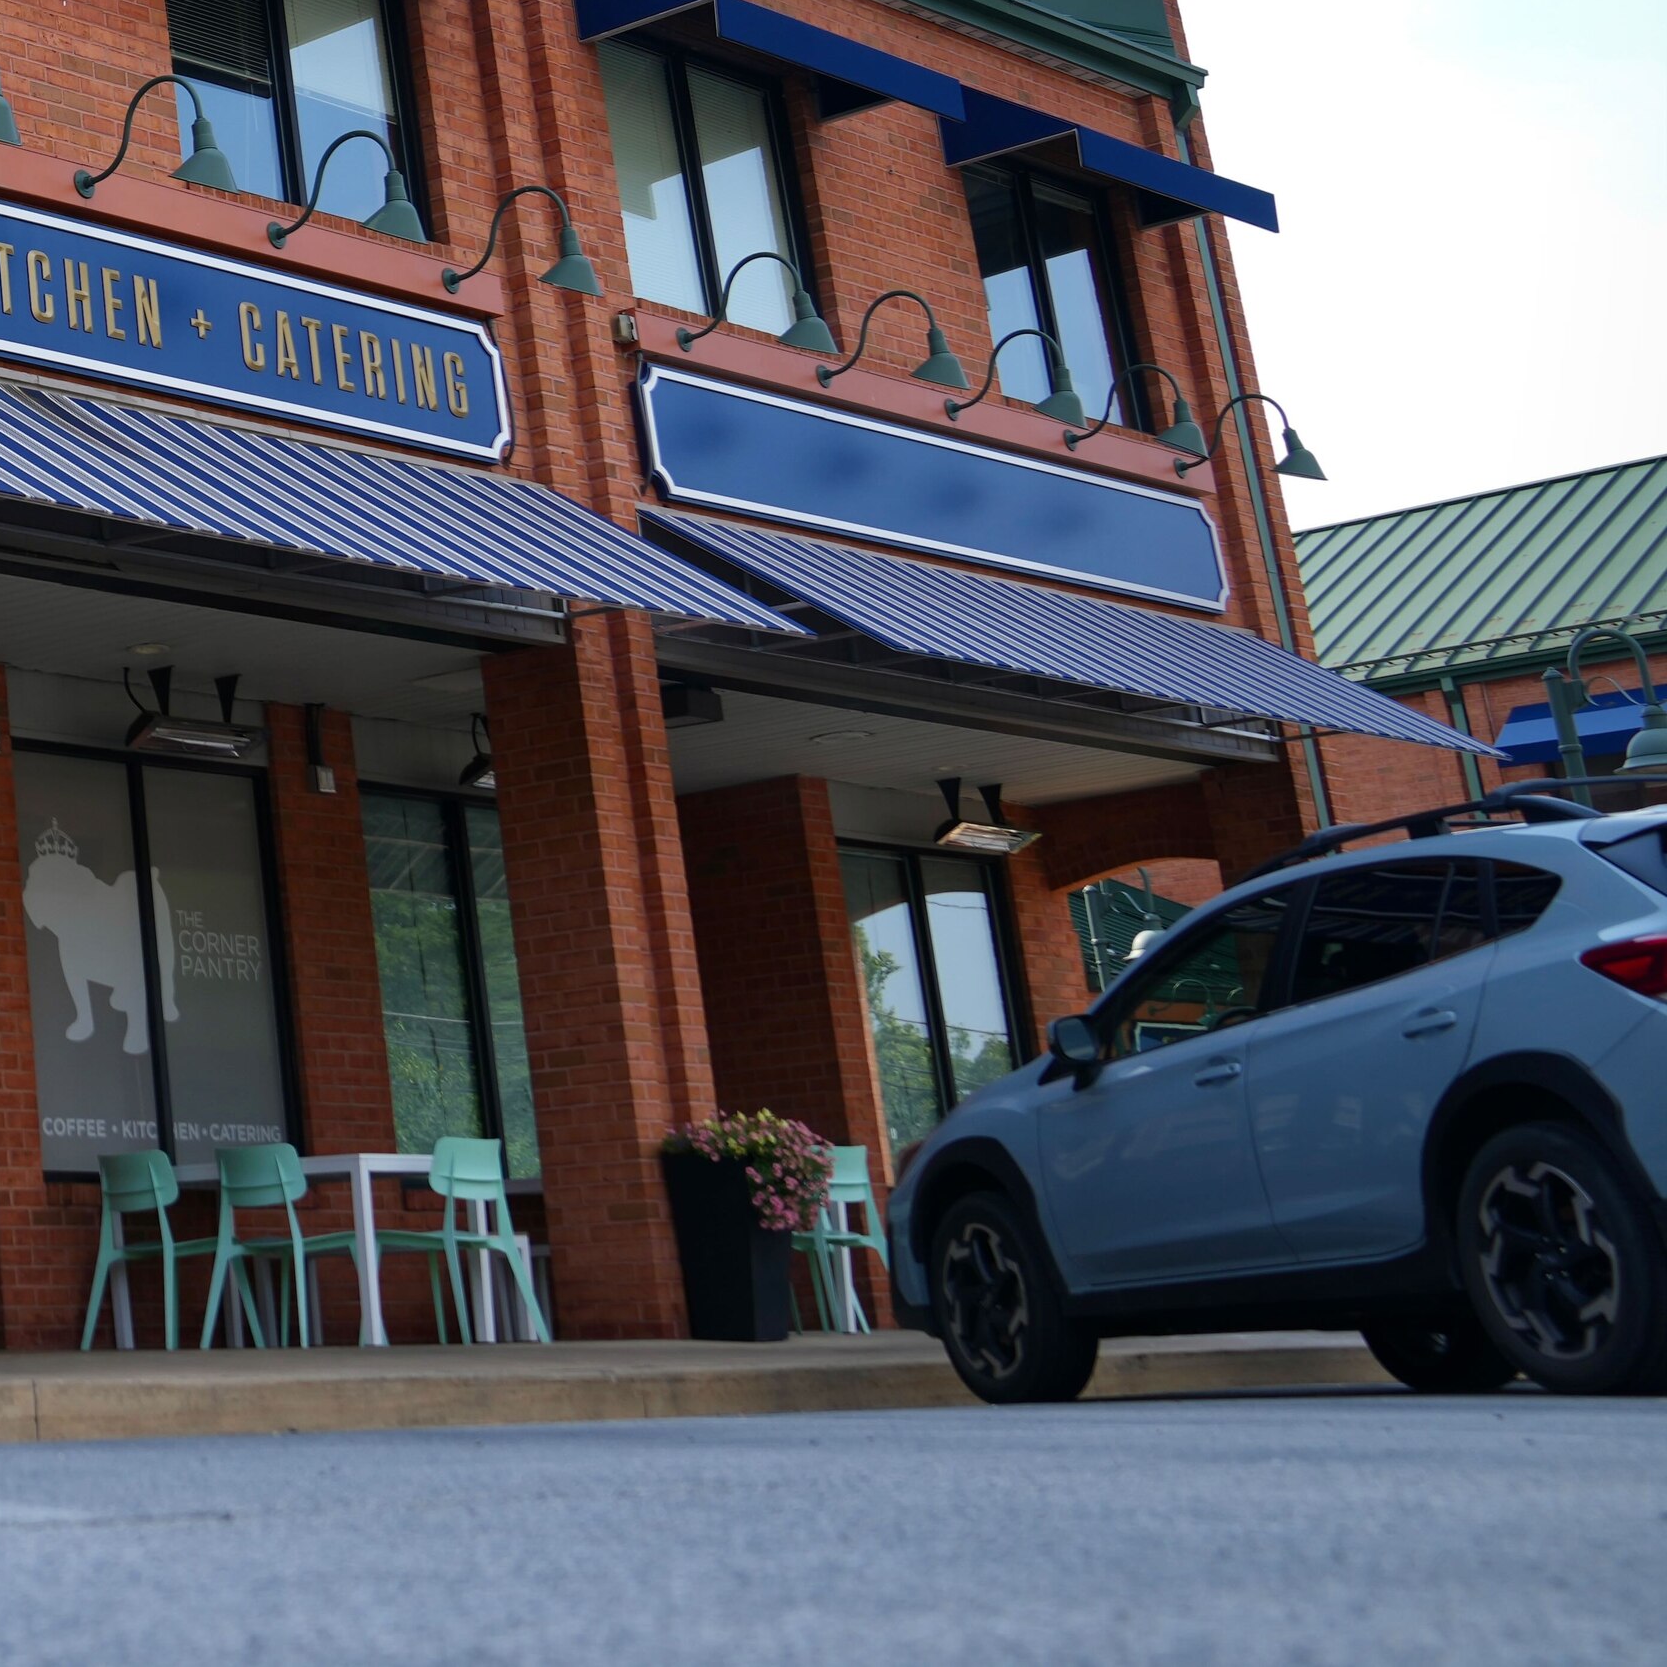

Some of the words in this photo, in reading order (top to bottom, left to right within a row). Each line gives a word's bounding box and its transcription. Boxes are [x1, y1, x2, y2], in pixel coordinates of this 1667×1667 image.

[238, 300, 469, 419] CATERING
[175, 909, 204, 929] THE
[178, 929, 260, 957] CORNER
[180, 954, 262, 982] PANTRY
[42, 1117, 107, 1138] COFFEE
[209, 1122, 282, 1143] CATERING
